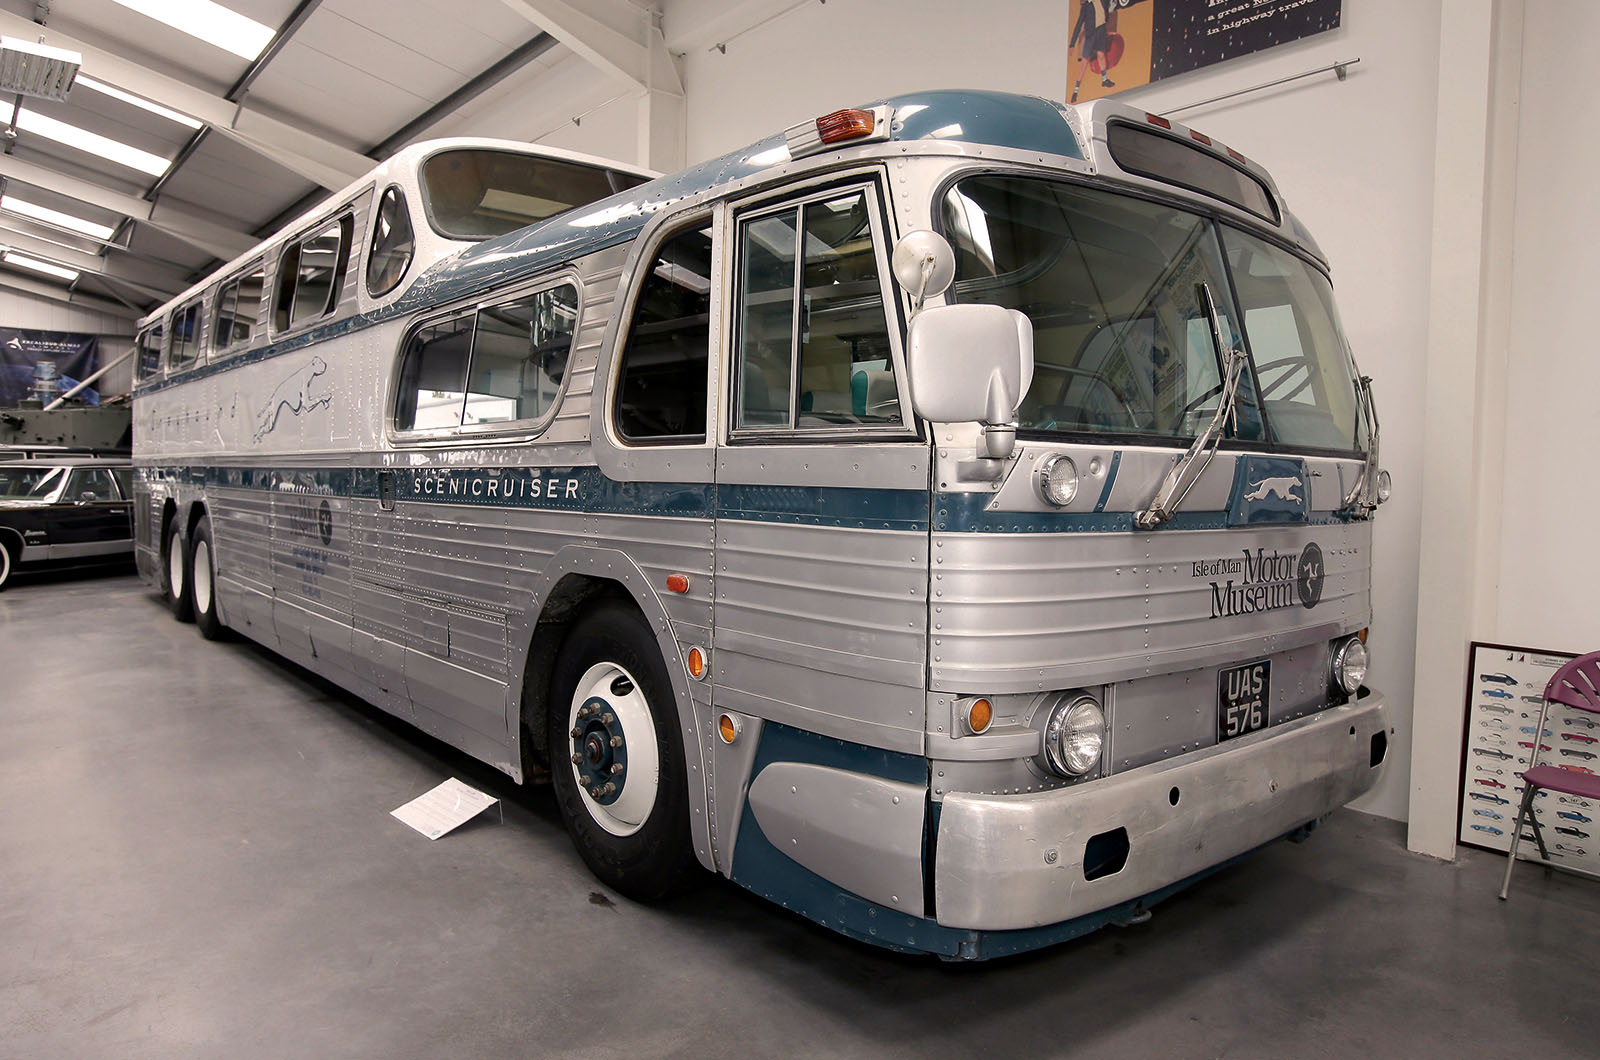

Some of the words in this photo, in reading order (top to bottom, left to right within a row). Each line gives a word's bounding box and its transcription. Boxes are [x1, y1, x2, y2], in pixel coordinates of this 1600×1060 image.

[1206, 28, 1220, 36] in
[1222, 9, 1277, 31] highway
[1278, 0, 1317, 12] trav
[1217, 3, 1251, 19] great
[413, 477, 580, 499] SCENICRUISER
[1191, 560, 1209, 578] Isle
[1209, 559, 1221, 576] of
[1220, 559, 1242, 575] Man
[1242, 547, 1297, 586] Motor
[1209, 580, 1296, 619] Museum
[1227, 665, 1264, 700] UAS
[1226, 700, 1263, 737] 576
